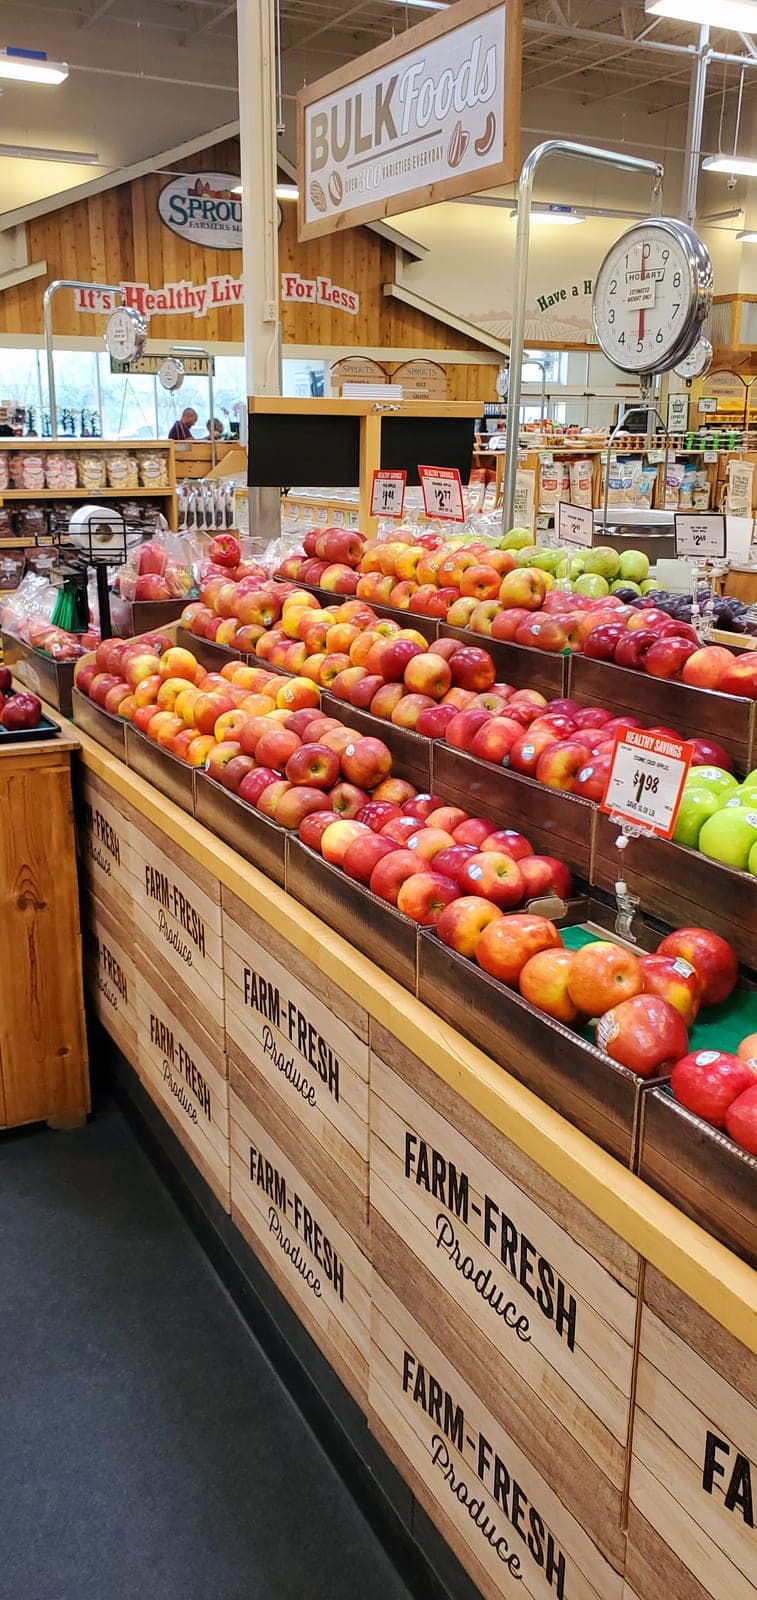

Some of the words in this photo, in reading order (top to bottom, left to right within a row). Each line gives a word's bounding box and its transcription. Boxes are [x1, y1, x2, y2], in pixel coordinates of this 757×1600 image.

[311, 74, 398, 173] BULK
[400, 35, 497, 135] Foods
[359, 163, 382, 193] 300
[382, 157, 411, 179] VARIETIES
[412, 145, 444, 170] EVERYDAY
[189, 221, 230, 231] FARMERS
[628, 271, 662, 281] HOART
[661, 250, 670, 266] 9
[78, 288, 111, 308] It's
[125, 286, 207, 316] Healthy
[286, 277, 314, 298] For
[321, 280, 356, 310] Less
[536, 289, 567, 312] Have
[571, 286, 579, 296] a
[609, 280, 617, 295] 2
[673, 272, 681, 288] 8
[608, 309, 615, 324] 3
[672, 304, 680, 319] 7
[618, 331, 626, 346] 4
[636, 338, 644, 353] 5
[656, 328, 664, 343] 6
[343, 365, 374, 374] SPROUTS
[407, 368, 436, 376] SPROUTS
[626, 732, 654, 749] HEALTHY
[654, 740, 682, 758] SAVINGS
[145, 865, 206, 958] FARM-FRESH
[158, 908, 193, 967] Produce
[244, 968, 339, 1103] FARM-FRESH
[150, 1015, 211, 1122] FARM-FRESH
[262, 1025, 316, 1107] Produce
[162, 1060, 198, 1125] Produce
[250, 1147, 344, 1304] FARM-FRESH
[405, 1132, 577, 1353] FARM-FRESH
[268, 1207, 321, 1298] Produce
[436, 1213, 531, 1342] Produce
[402, 1350, 566, 1600] FARM-FRESH
[702, 1430, 754, 1529] FA
[431, 1434, 523, 1580] Produce
